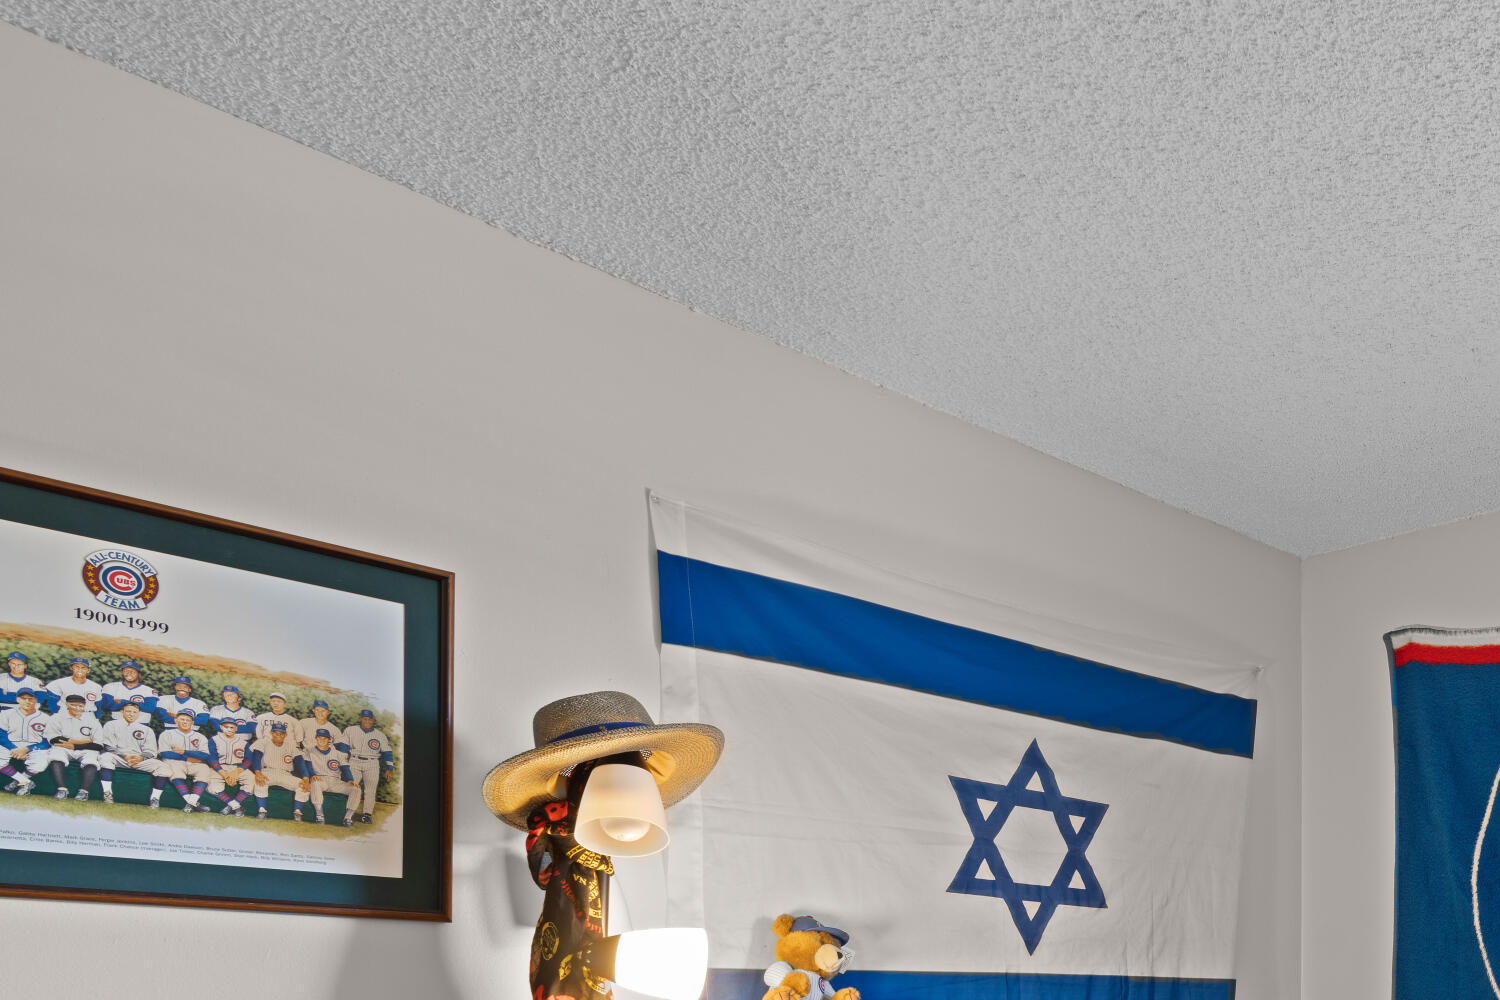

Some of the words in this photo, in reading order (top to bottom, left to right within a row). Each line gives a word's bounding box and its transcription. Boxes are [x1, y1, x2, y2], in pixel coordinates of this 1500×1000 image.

[89, 551, 154, 576] ALL-CENTURY
[108, 570, 137, 592] CUBS
[104, 594, 140, 609] TEAM
[73, 607, 169, 634] 1900-1999
